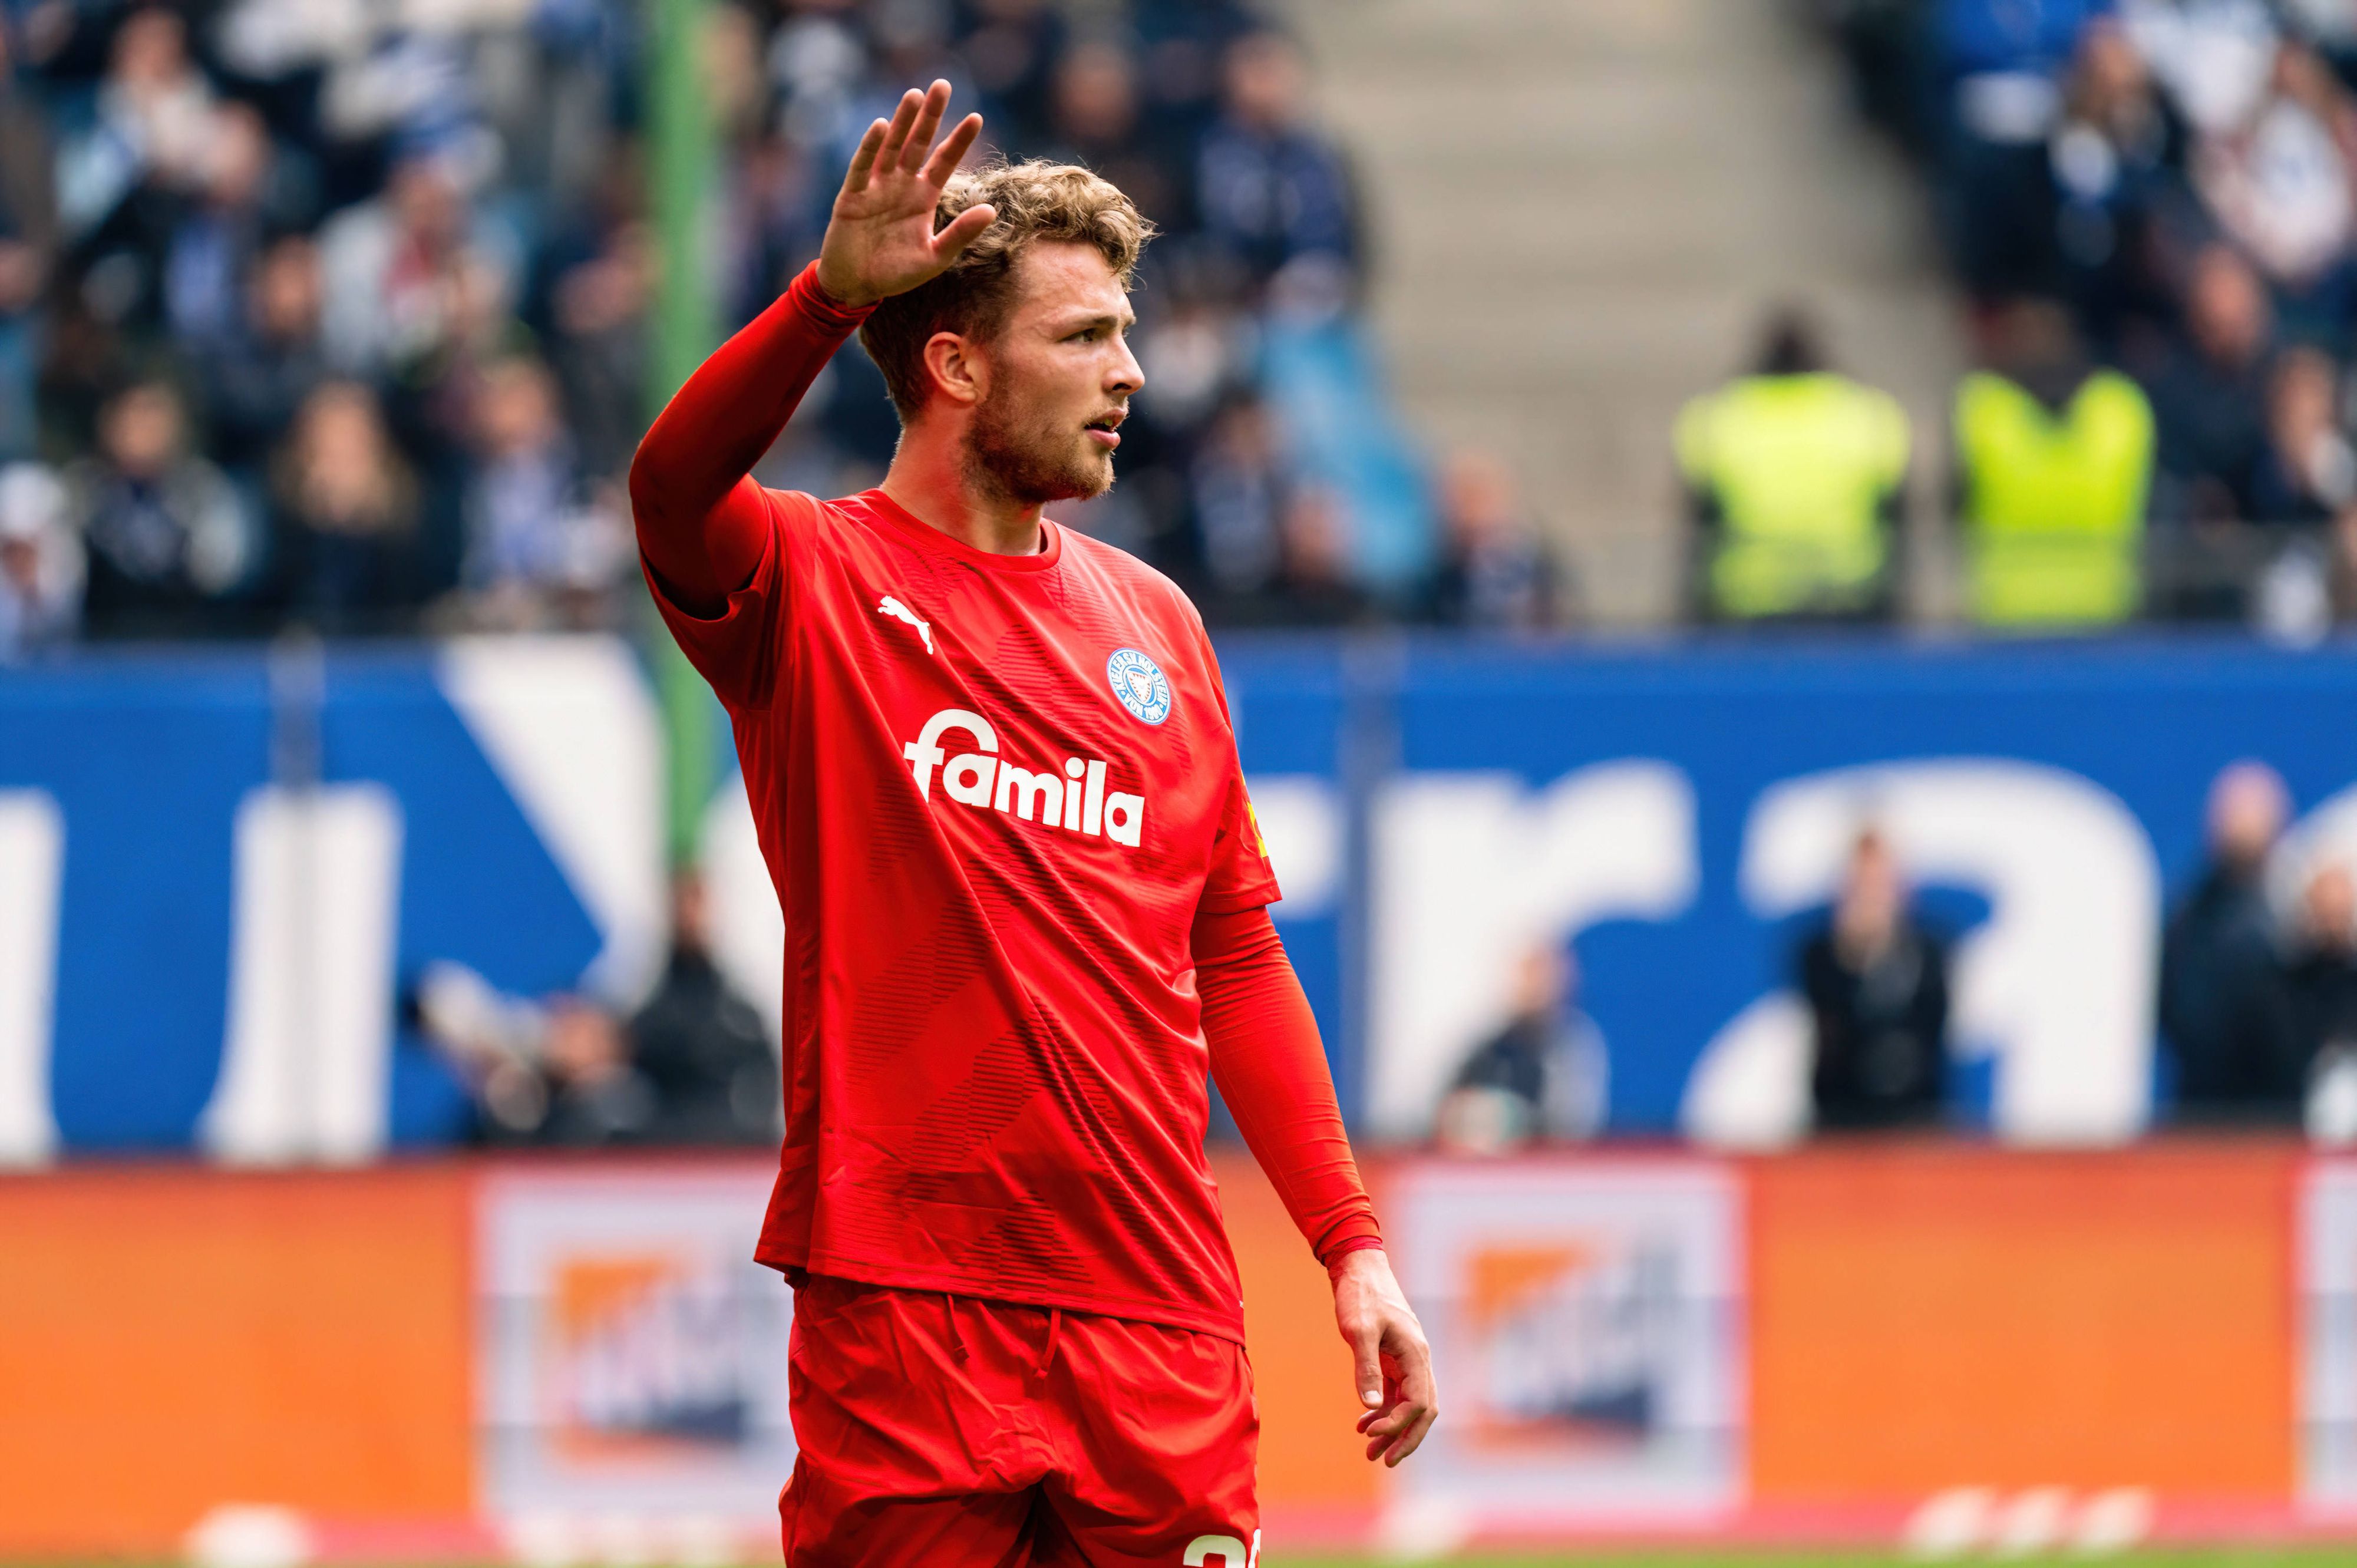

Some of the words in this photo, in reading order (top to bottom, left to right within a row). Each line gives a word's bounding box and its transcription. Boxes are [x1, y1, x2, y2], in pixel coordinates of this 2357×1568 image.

[1111, 655, 1128, 691] KIELER
[1138, 655, 1167, 706] HOLSTEIN
[1124, 694, 1143, 717] VON
[903, 709, 1144, 847] famila
